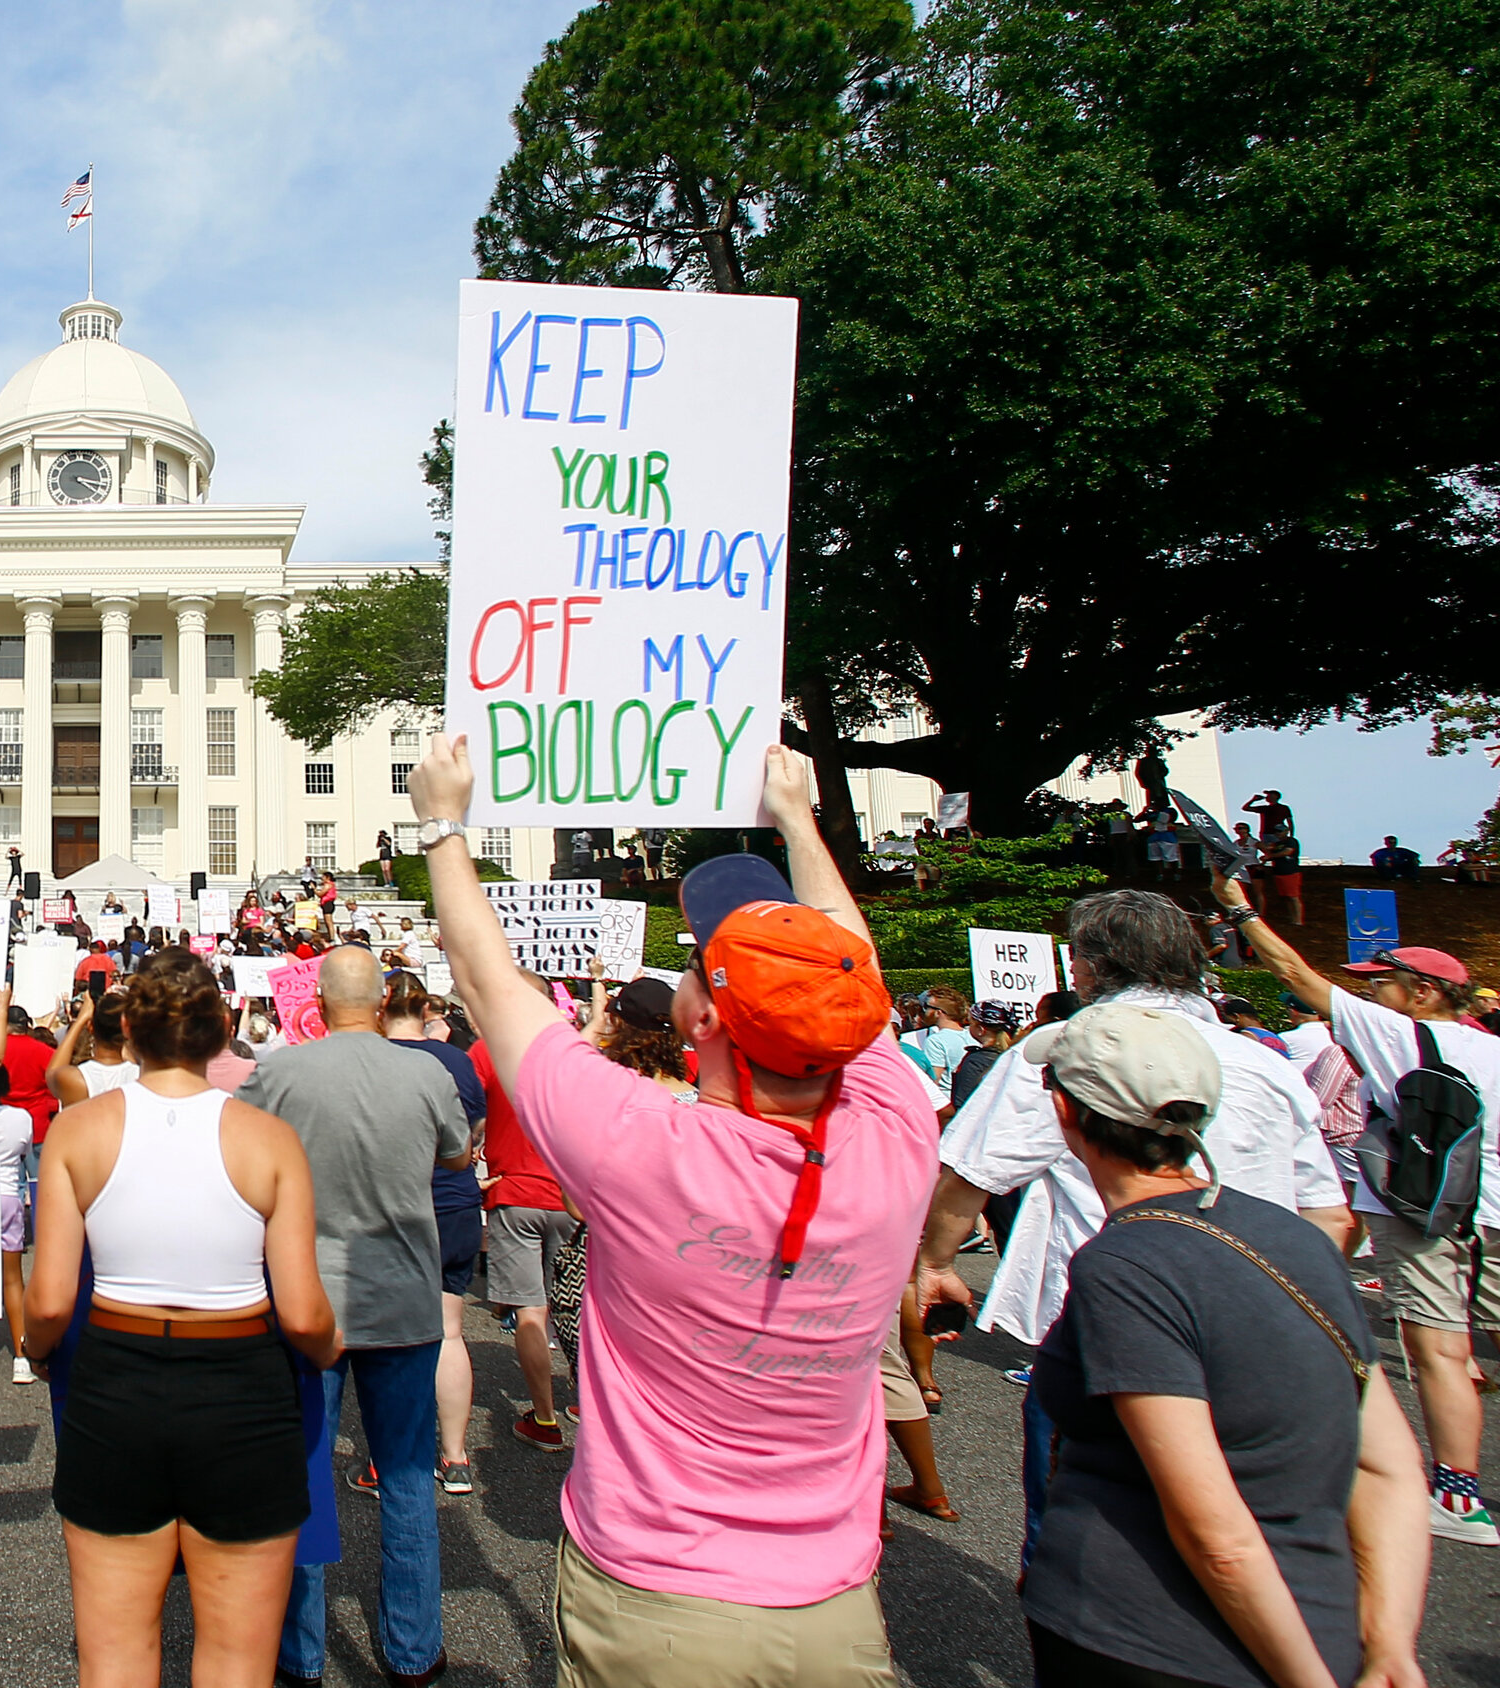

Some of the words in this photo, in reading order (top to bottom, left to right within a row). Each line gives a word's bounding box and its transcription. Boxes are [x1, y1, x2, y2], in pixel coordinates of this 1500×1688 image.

[484, 310, 666, 430] KEEP
[552, 446, 672, 525] YOUR
[563, 523, 785, 611] THEOLOGY
[469, 596, 602, 695] OFF
[642, 633, 739, 704] MY
[487, 699, 754, 811] BIOLOGY
[485, 885, 521, 898] EER
[530, 883, 596, 897] RIGHTS
[529, 899, 595, 912] RIGHTS
[605, 900, 622, 913] 25
[503, 916, 542, 928] EN'S
[600, 914, 633, 932] ORS
[533, 927, 599, 940] RIGHTS
[517, 943, 598, 958] HUMAN
[622, 947, 642, 960] OF
[994, 943, 1028, 963] HER
[294, 962, 316, 975] WE
[990, 970, 1036, 993] BODY
[677, 1214, 861, 1300] Empthy
